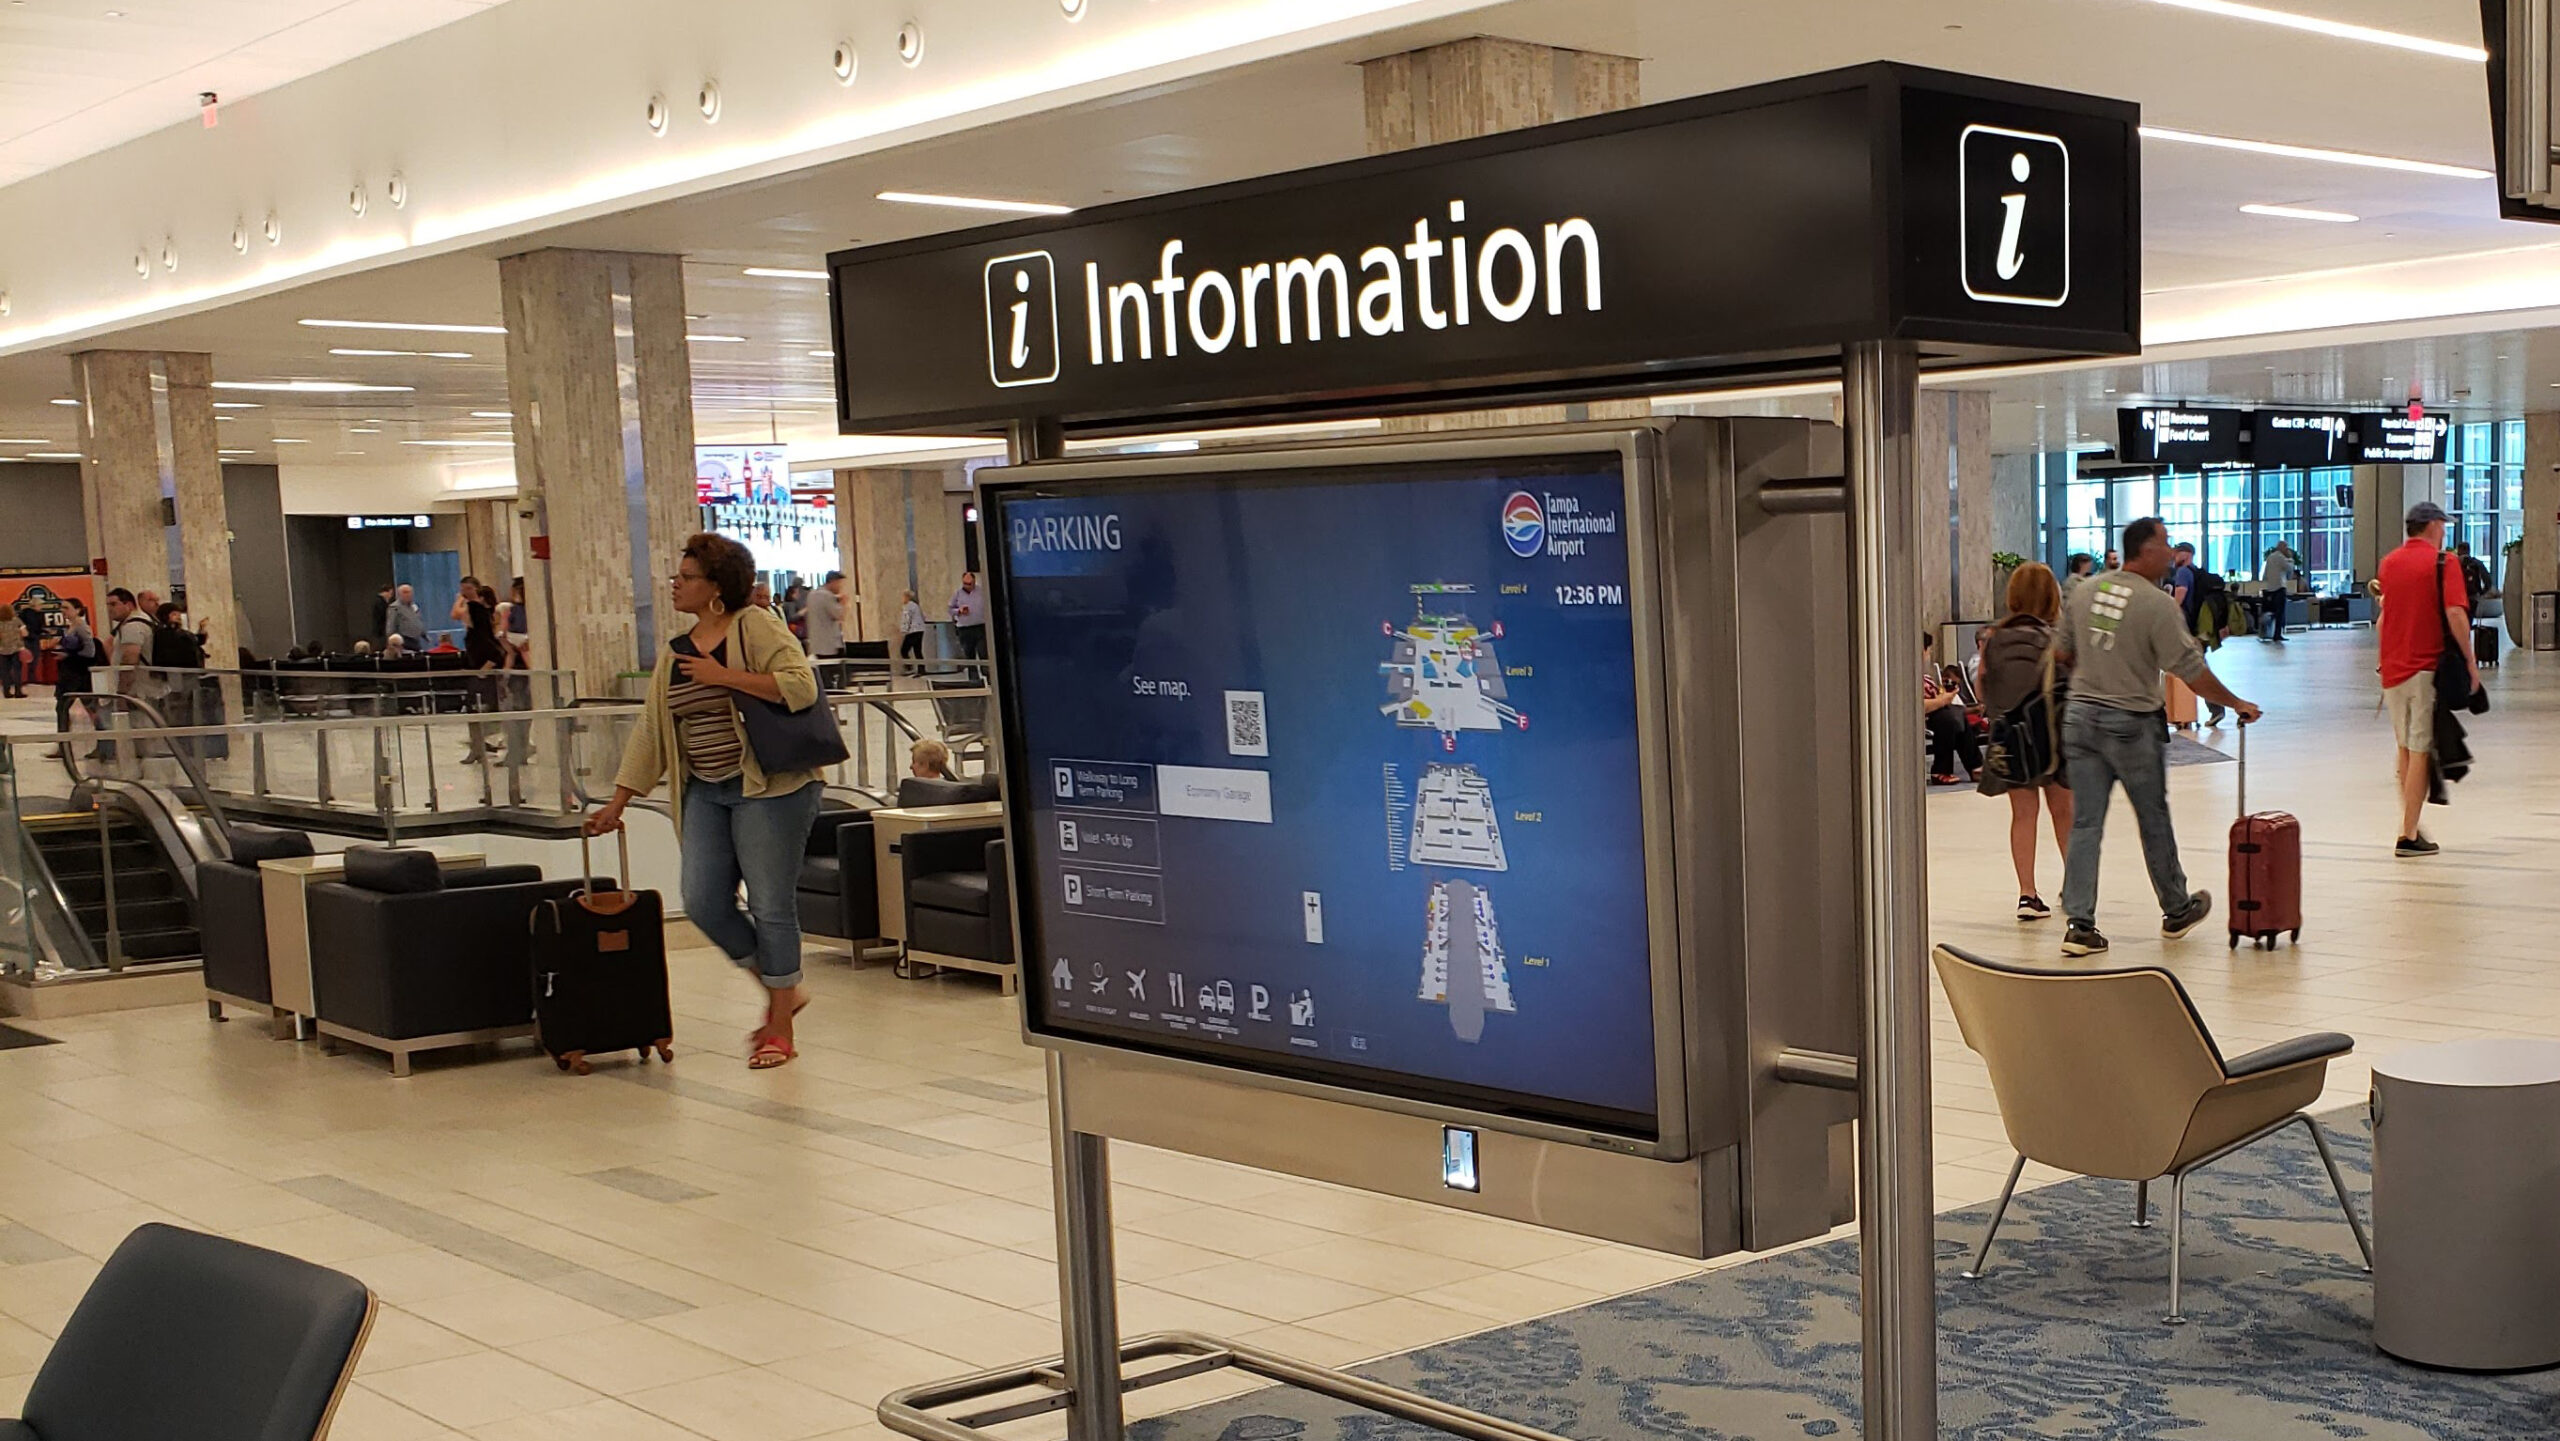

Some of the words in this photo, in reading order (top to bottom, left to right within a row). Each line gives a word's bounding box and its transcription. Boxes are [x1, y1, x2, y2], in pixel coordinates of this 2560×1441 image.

[1085, 200, 1602, 365] Information
[2170, 429, 2188, 441] Food
[2189, 429, 2210, 441] Court
[1543, 491, 1580, 518] Tampa
[1547, 509, 1616, 535] International
[1014, 514, 1122, 552] PARKING
[1547, 534, 1586, 562] Airport
[1555, 585, 1595, 605] 12:36
[1598, 585, 1623, 605] PM
[1495, 624, 1503, 636] A
[1133, 676, 1156, 695] See
[1159, 680, 1191, 701] map.
[1519, 716, 1528, 728] F
[1446, 739, 1453, 751] E
[1119, 773, 1138, 789] Long
[1096, 785, 1124, 802] Parking
[1515, 810, 1537, 822] Level
[1121, 834, 1134, 849] Up
[1524, 955, 1544, 966] Level
